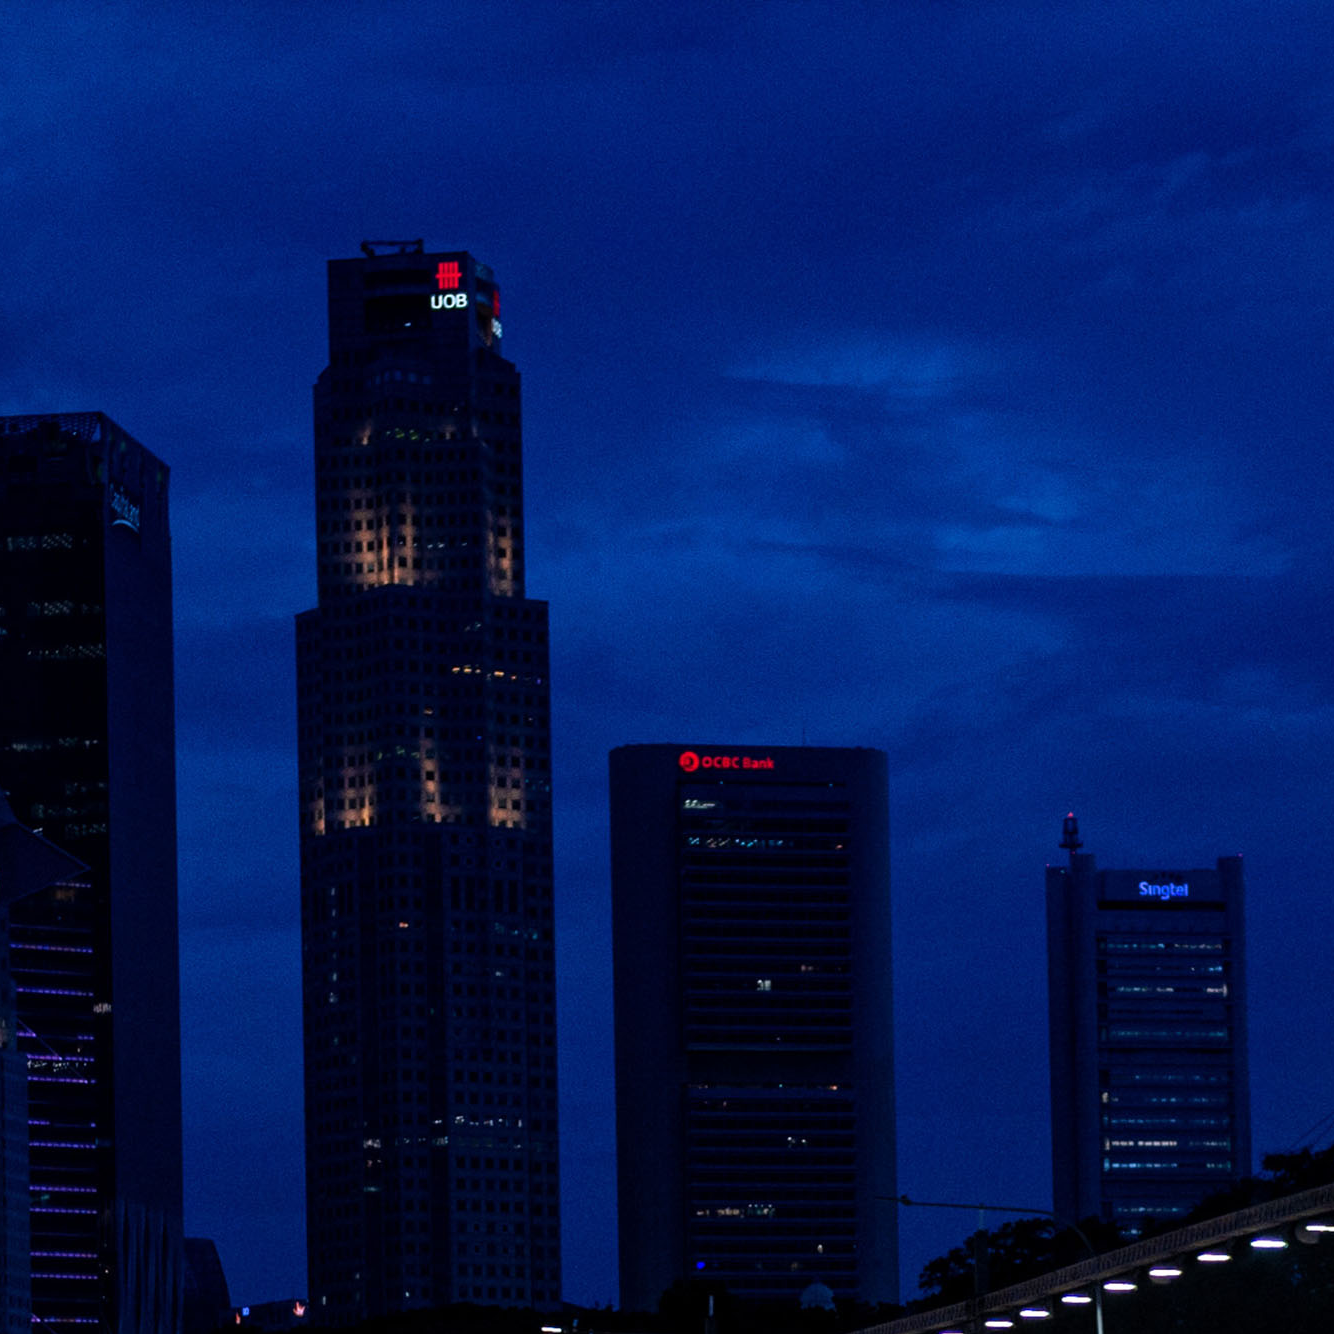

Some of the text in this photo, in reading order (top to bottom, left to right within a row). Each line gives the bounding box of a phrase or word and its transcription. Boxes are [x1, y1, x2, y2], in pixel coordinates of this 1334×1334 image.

[430, 292, 468, 310] UOB
[701, 755, 775, 771] OCBC Bank
[1139, 881, 1189, 900] Singtel
